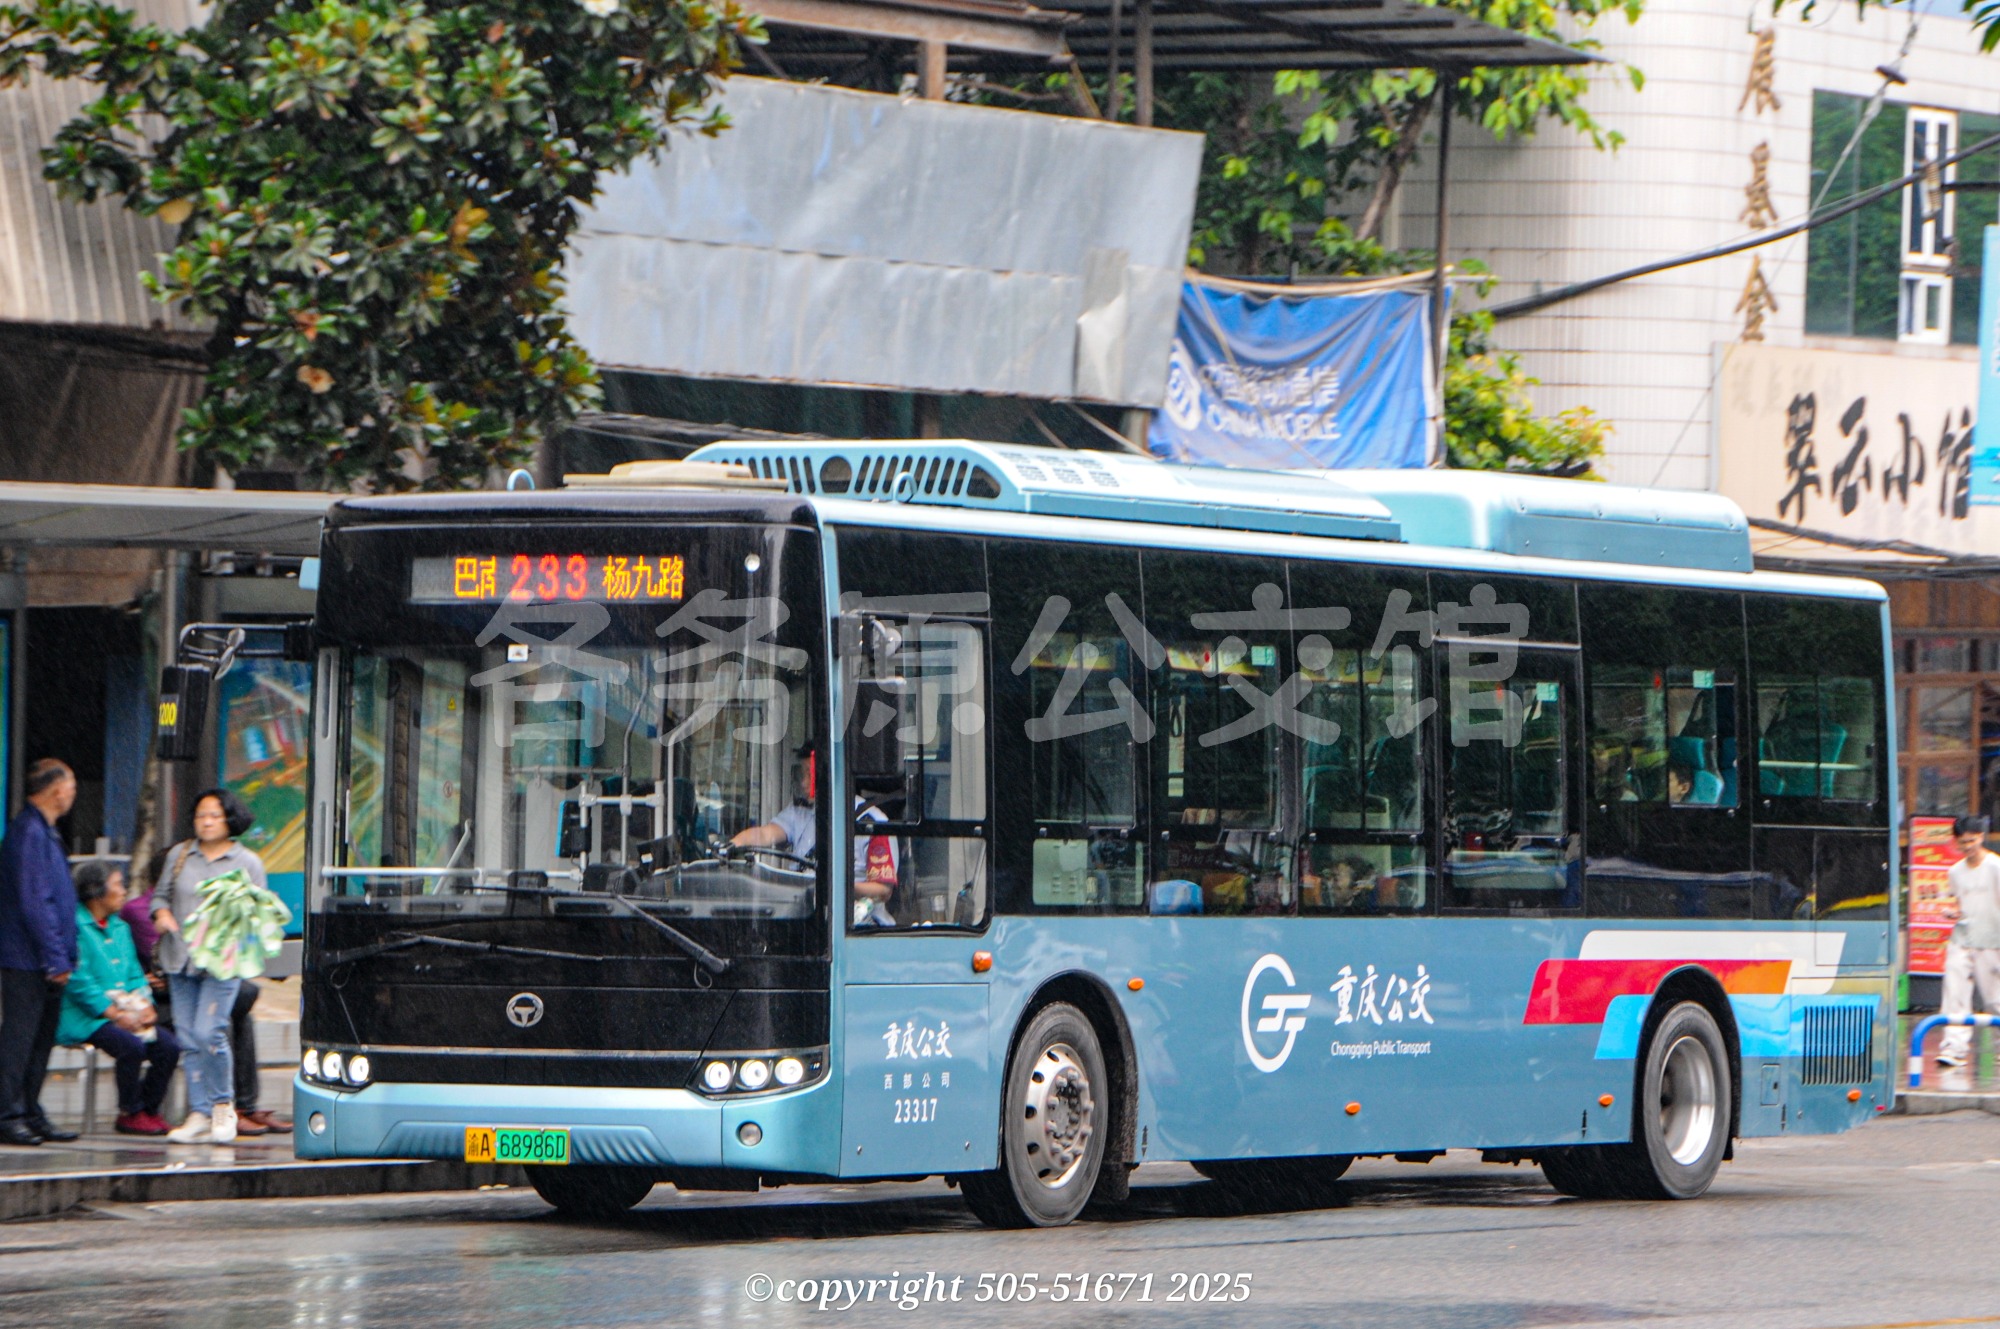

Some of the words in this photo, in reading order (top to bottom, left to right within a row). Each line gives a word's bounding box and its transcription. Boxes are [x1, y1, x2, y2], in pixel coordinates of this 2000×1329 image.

[510, 553, 588, 600] 233
[602, 555, 685, 600] 杨九路
[1329, 963, 1434, 1026] 重庆公交
[882, 1020, 952, 1060] 重庆公交
[1373, 1040, 1395, 1055] Public
[1396, 1040, 1431, 1058] Transport
[884, 1072, 950, 1090] 西部公司
[894, 1098, 938, 1123] 23317
